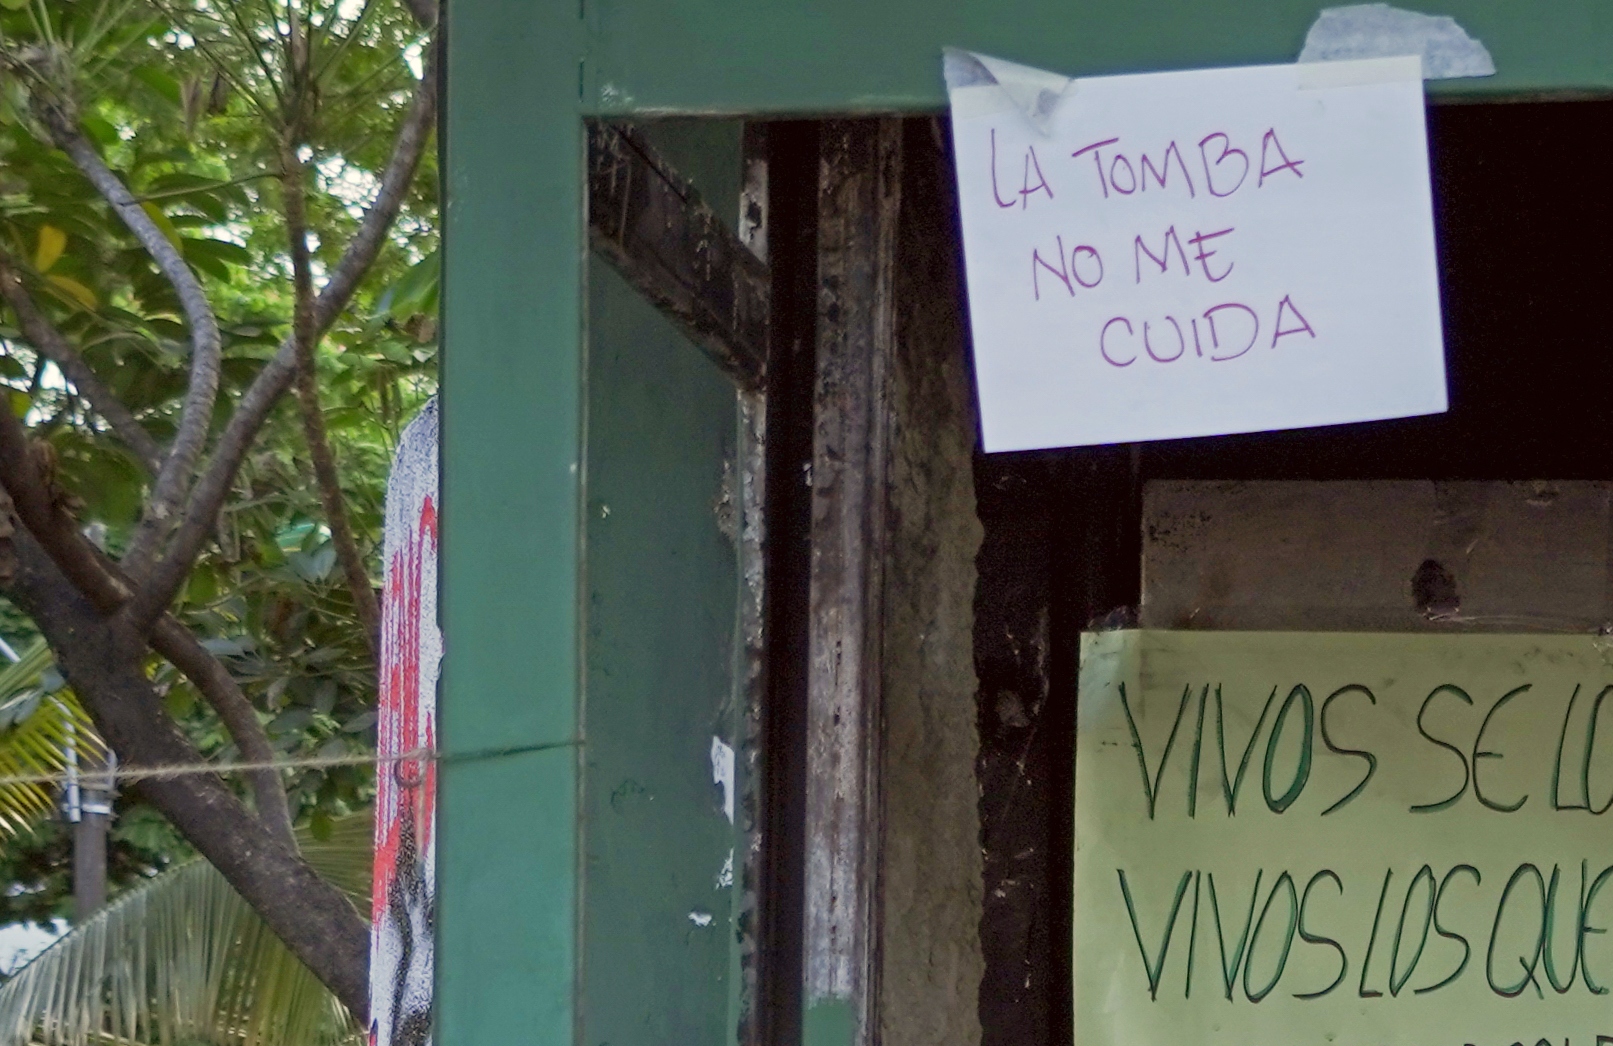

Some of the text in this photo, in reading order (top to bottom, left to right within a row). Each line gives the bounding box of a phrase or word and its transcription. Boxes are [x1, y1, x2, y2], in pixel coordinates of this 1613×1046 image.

[991, 127, 1305, 210] LA TOMBA
[1032, 225, 1235, 300] NO ME
[1100, 294, 1316, 367] CUIDA
[1118, 681, 1377, 821] VIVOS
[1409, 683, 1532, 814] SE
[1116, 868, 1349, 1004] VIVOS
[1359, 864, 1482, 998] LOS
